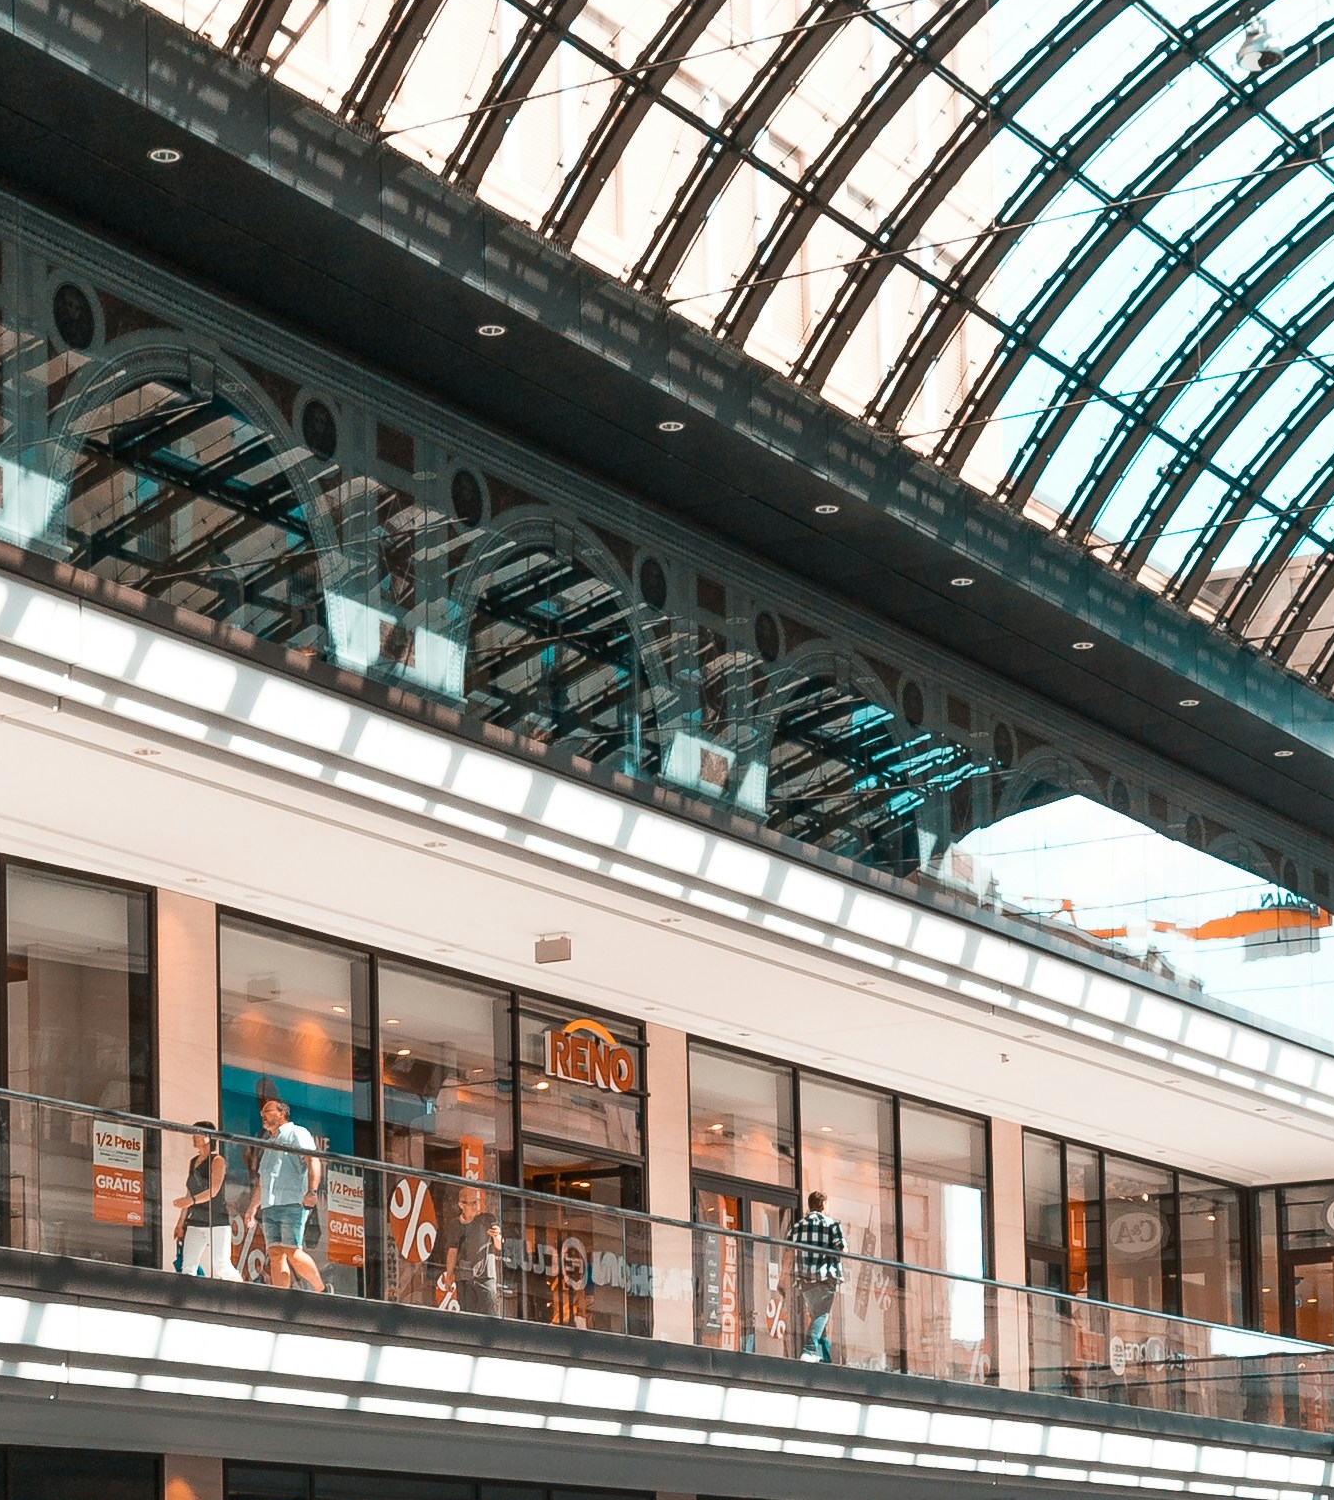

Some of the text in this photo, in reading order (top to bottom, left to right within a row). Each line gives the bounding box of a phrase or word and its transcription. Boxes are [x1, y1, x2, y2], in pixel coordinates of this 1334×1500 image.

[545, 1030, 635, 1093] RENO
[96, 1132, 141, 1152] 1/2 Preis
[95, 1175, 142, 1194] GRATIS
[329, 1180, 364, 1197] 1/2 Preis
[329, 1219, 364, 1237] GRATIS
